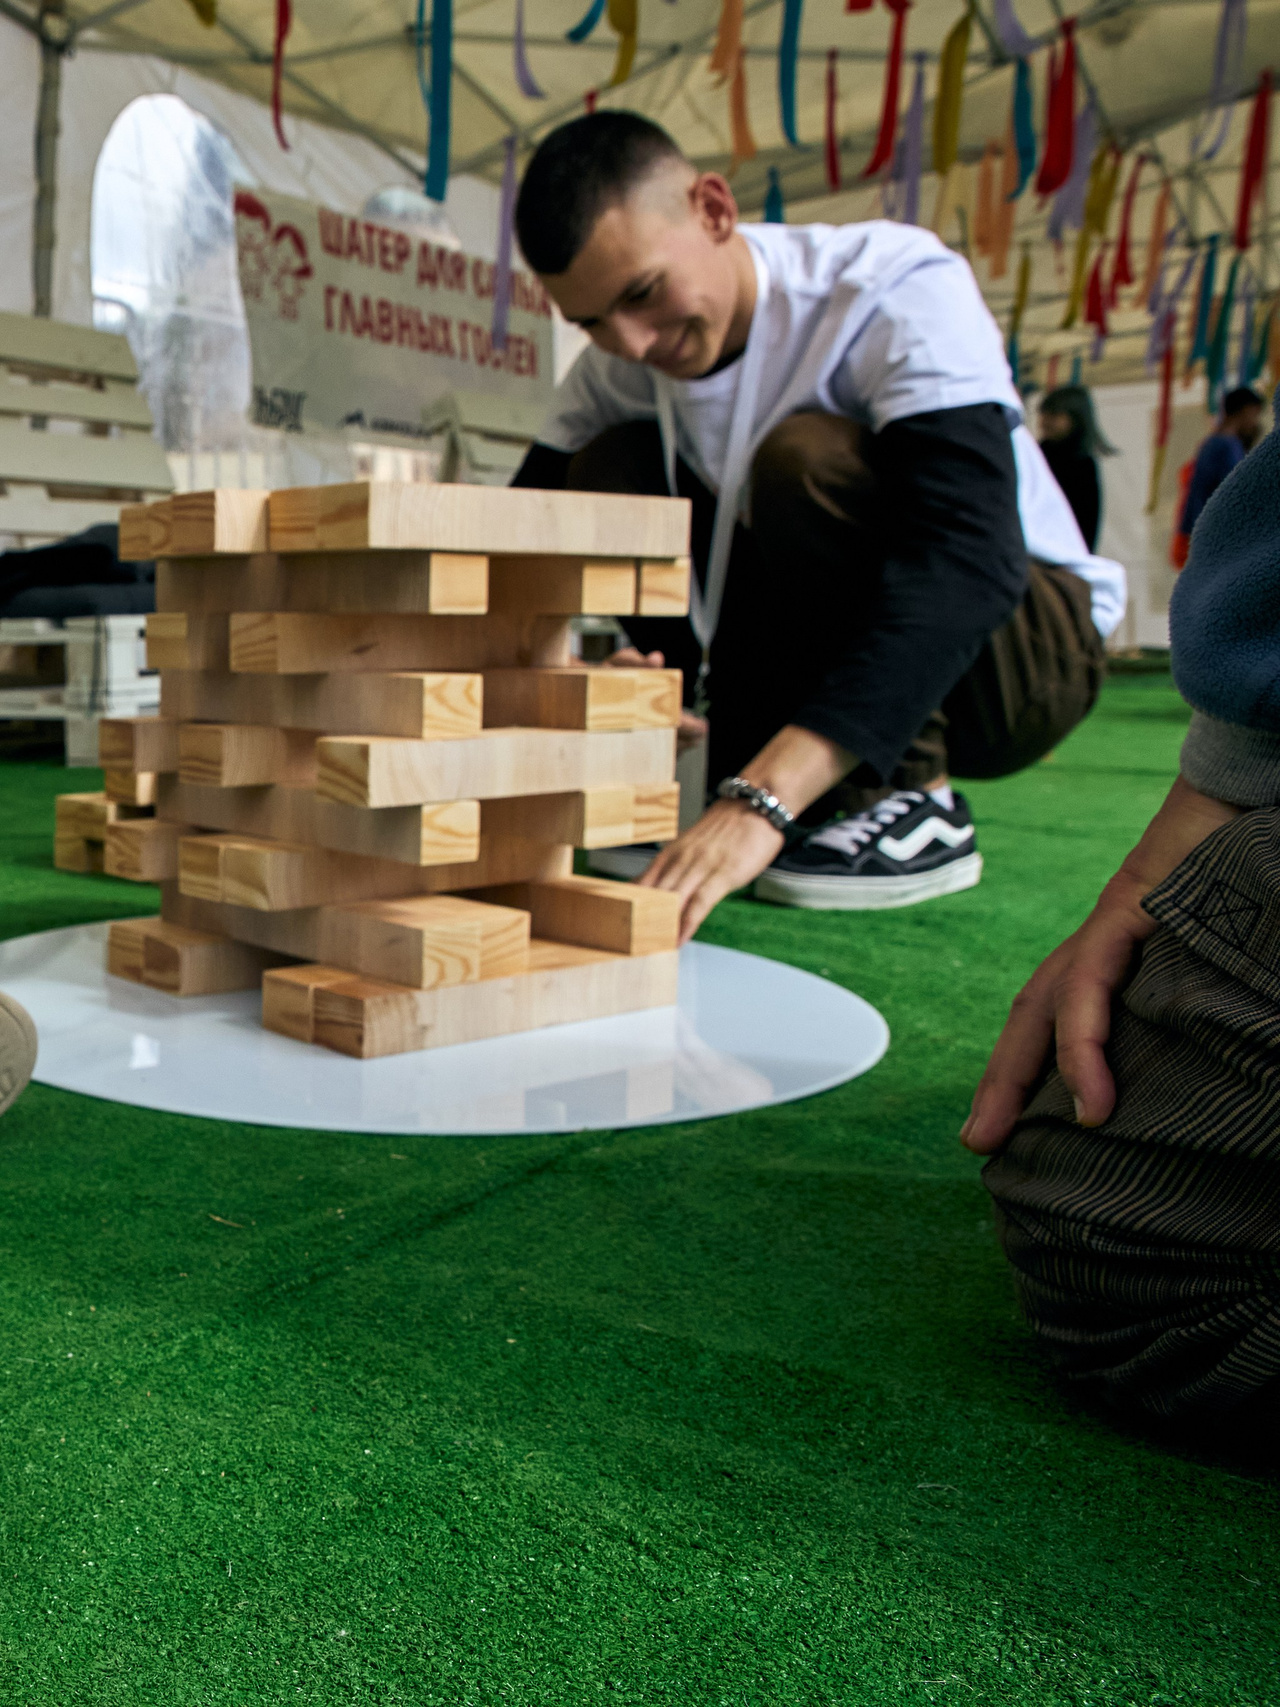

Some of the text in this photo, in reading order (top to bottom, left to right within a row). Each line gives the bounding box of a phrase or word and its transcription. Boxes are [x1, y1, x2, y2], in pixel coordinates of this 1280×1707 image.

[318, 208, 411, 274] ШАТЕР
[417, 241, 467, 293] ДЛЯ
[323, 284, 455, 358] ГЛАВНЫХ
